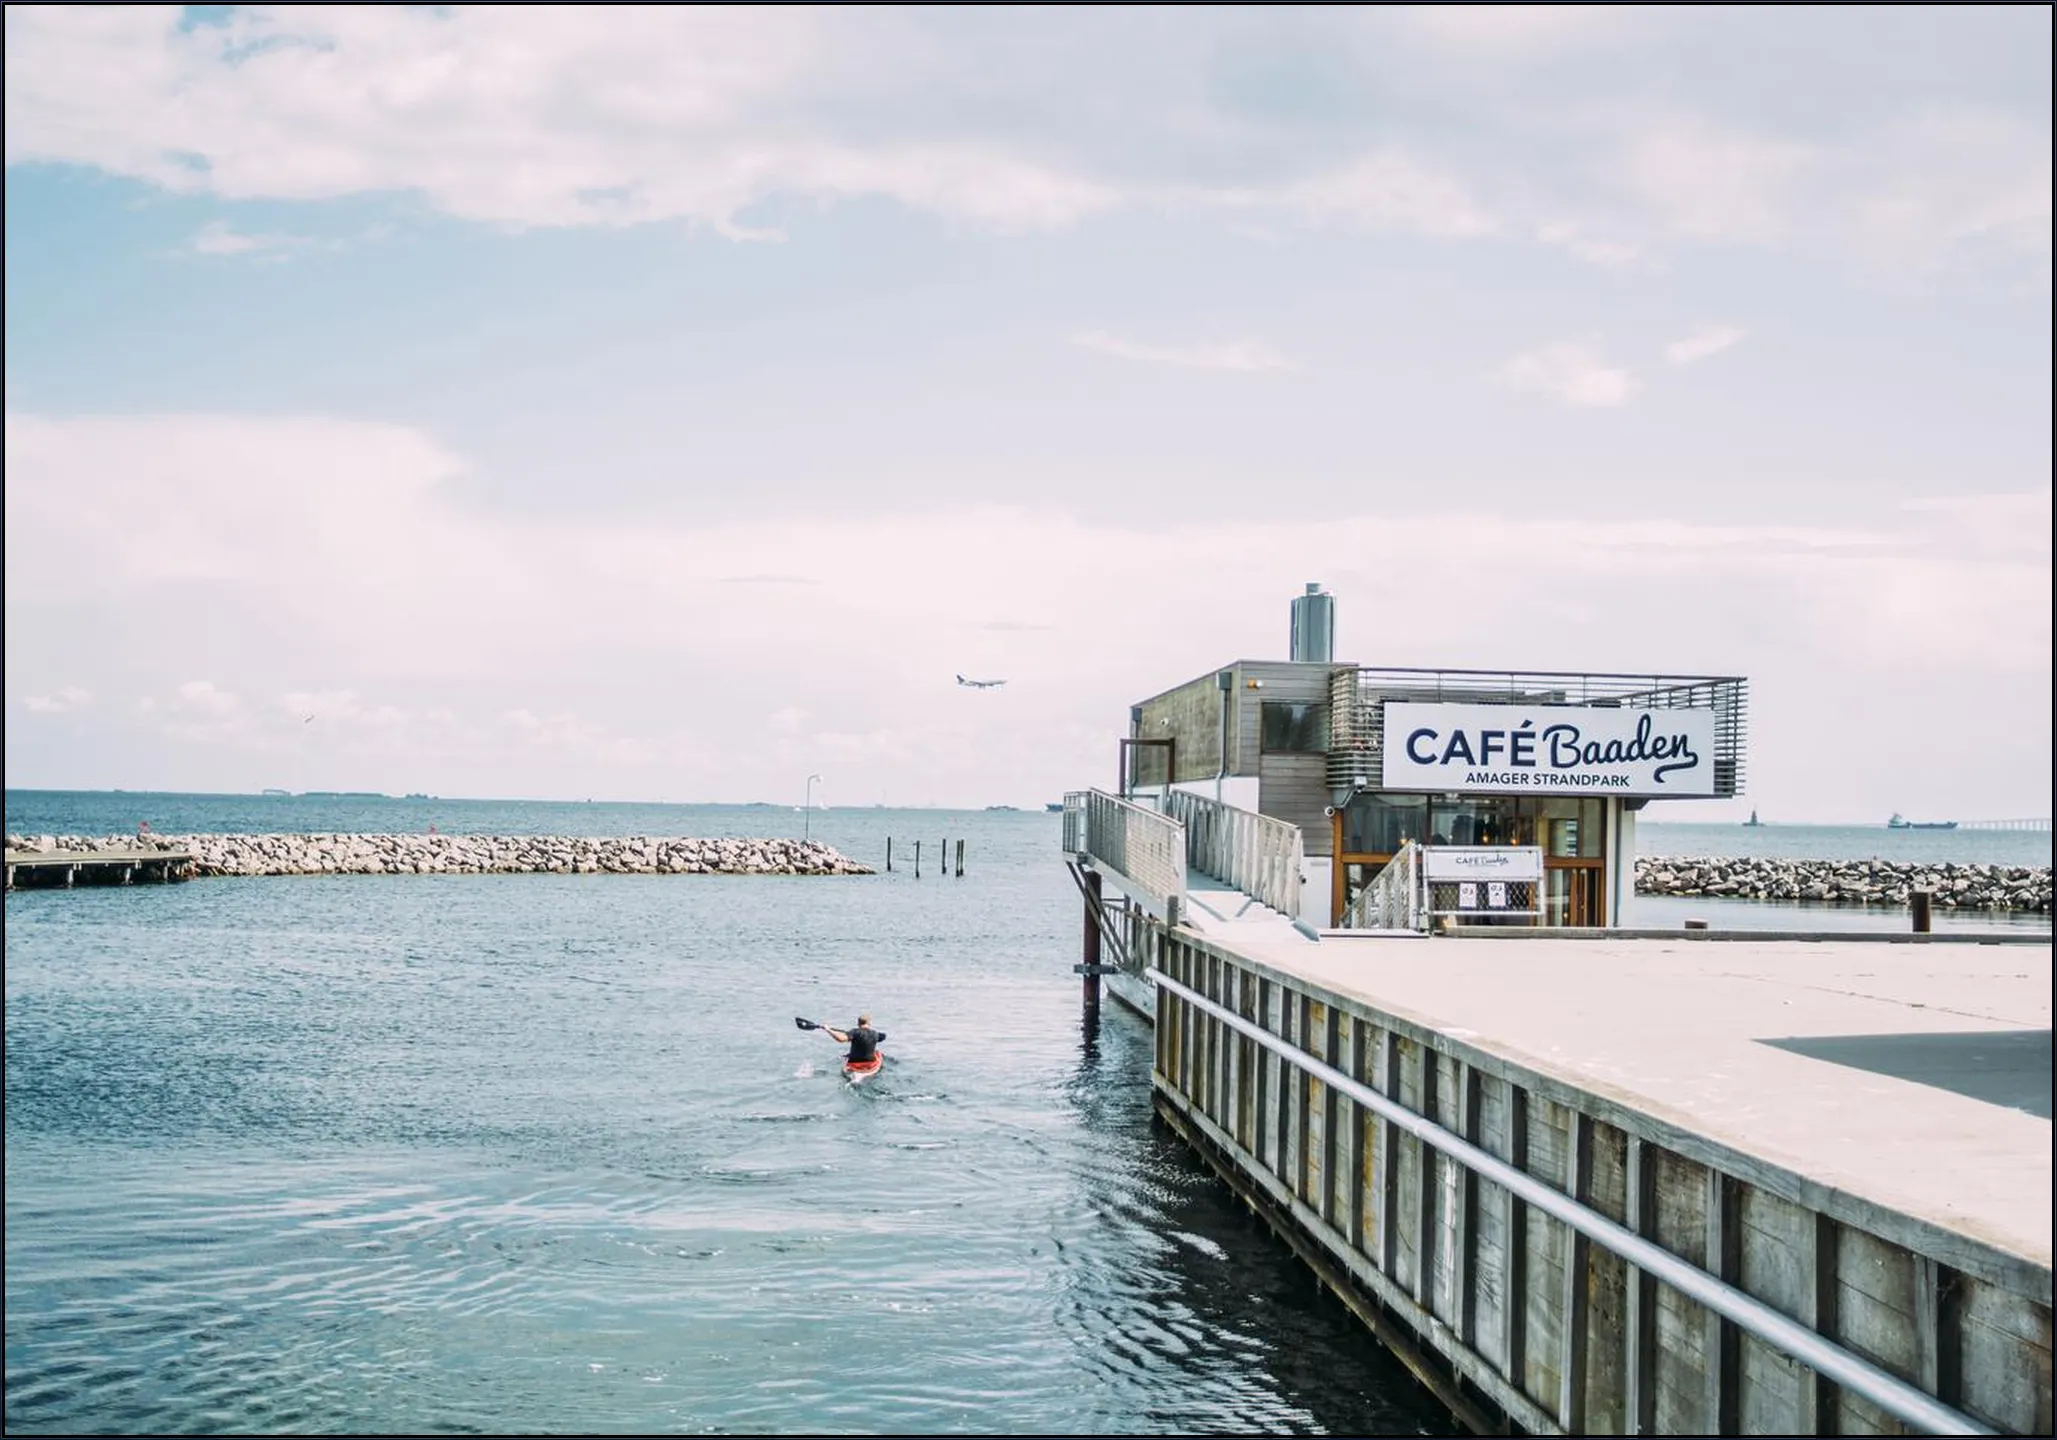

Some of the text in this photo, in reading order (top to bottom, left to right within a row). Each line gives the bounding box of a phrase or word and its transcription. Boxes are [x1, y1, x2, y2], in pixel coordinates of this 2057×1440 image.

[1406, 712, 1699, 784] CAFÉ Baaden
[1465, 773, 1630, 787] AMAGER STRANDPARK
